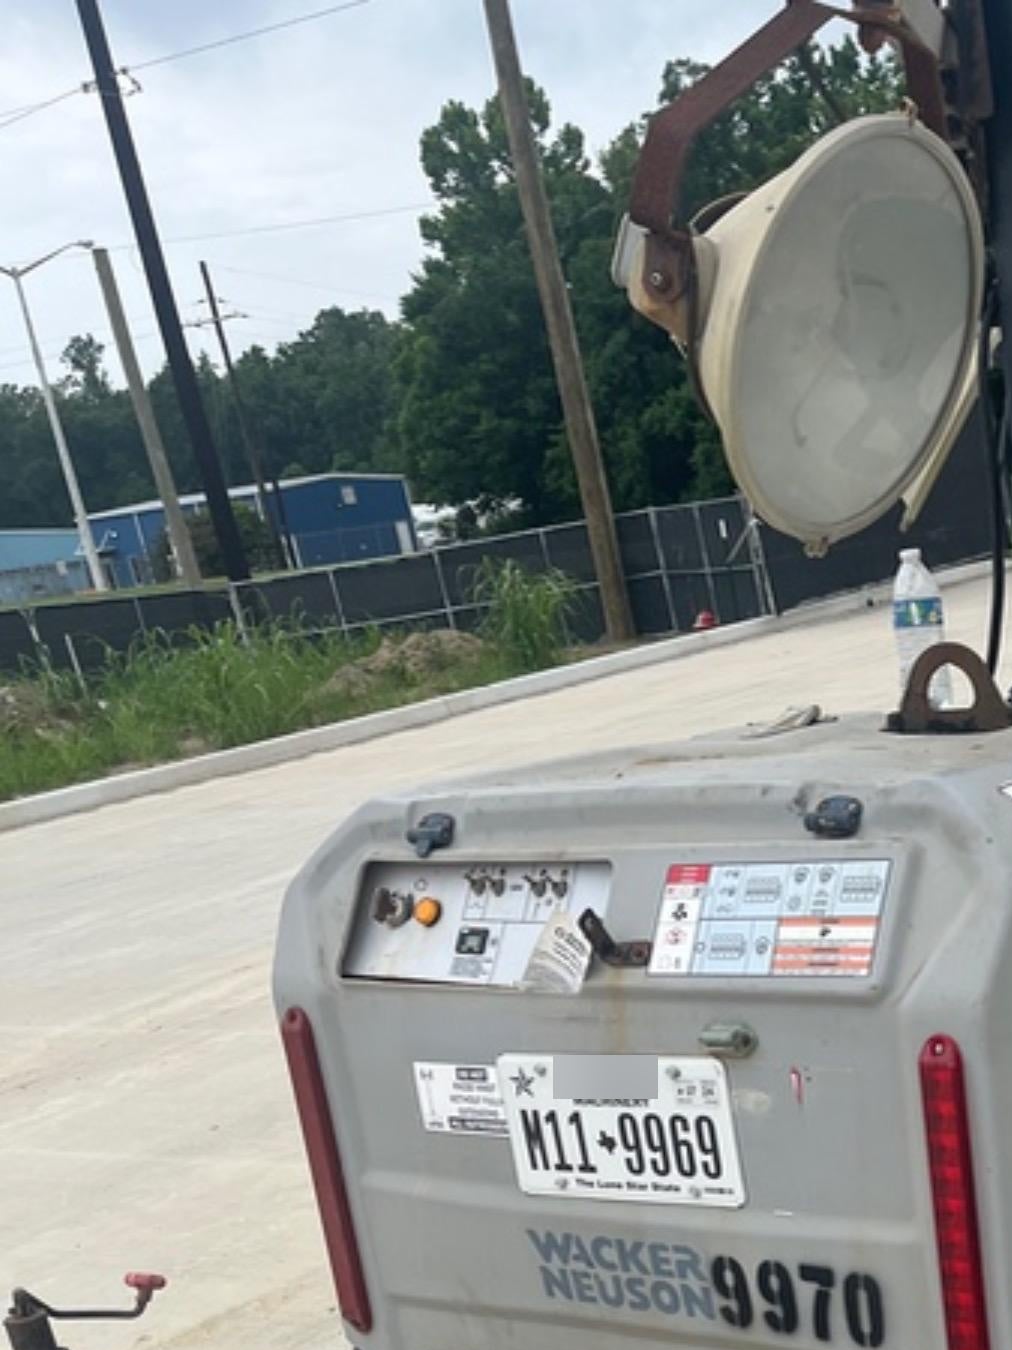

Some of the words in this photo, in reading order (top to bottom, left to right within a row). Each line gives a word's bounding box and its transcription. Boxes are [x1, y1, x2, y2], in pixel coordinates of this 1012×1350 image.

[520, 1109, 597, 1173] M11
[617, 1112, 722, 1179] 9969
[575, 1178, 594, 1189] The
[526, 1229, 708, 1281] WACKER
[539, 1266, 717, 1320] NEUSON
[709, 1255, 885, 1348] 9970
